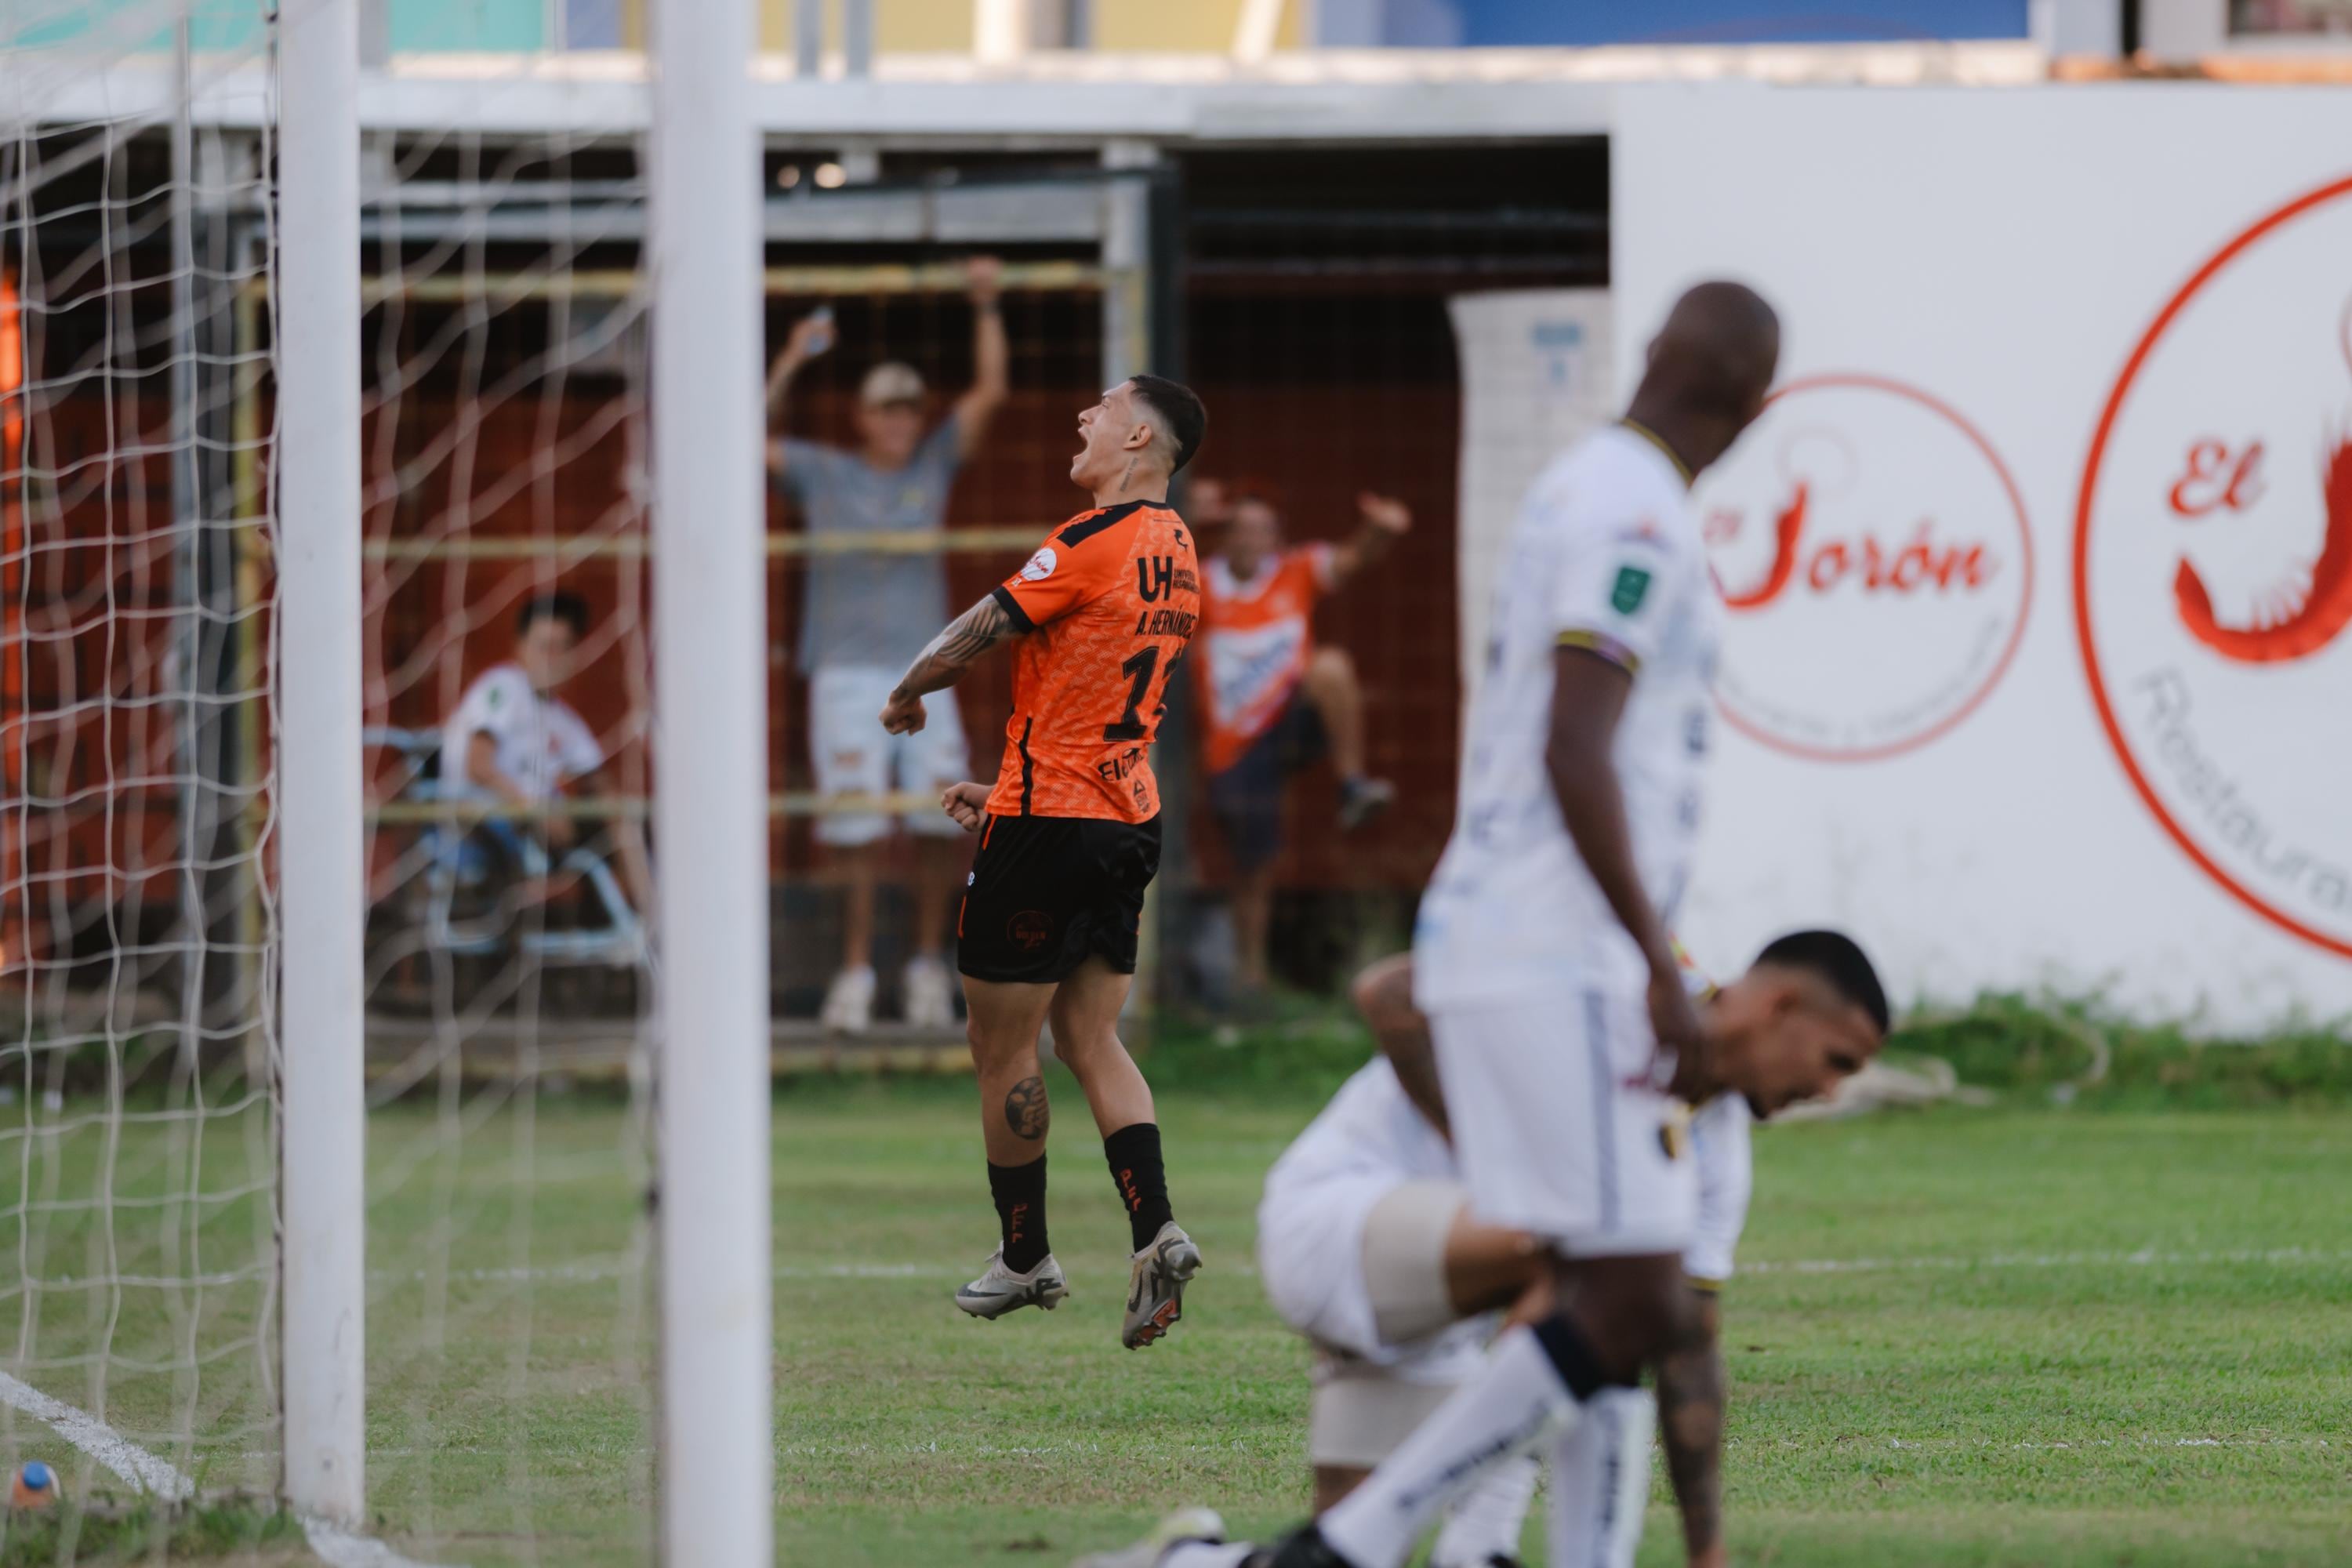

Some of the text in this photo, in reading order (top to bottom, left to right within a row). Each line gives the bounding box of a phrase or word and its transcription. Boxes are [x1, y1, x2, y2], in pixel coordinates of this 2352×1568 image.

[2169, 440, 2266, 517] El
[1138, 556, 1173, 602] UH
[1148, 604, 1198, 640] HERNÁNDE
[2129, 665, 2352, 913] Restaura
